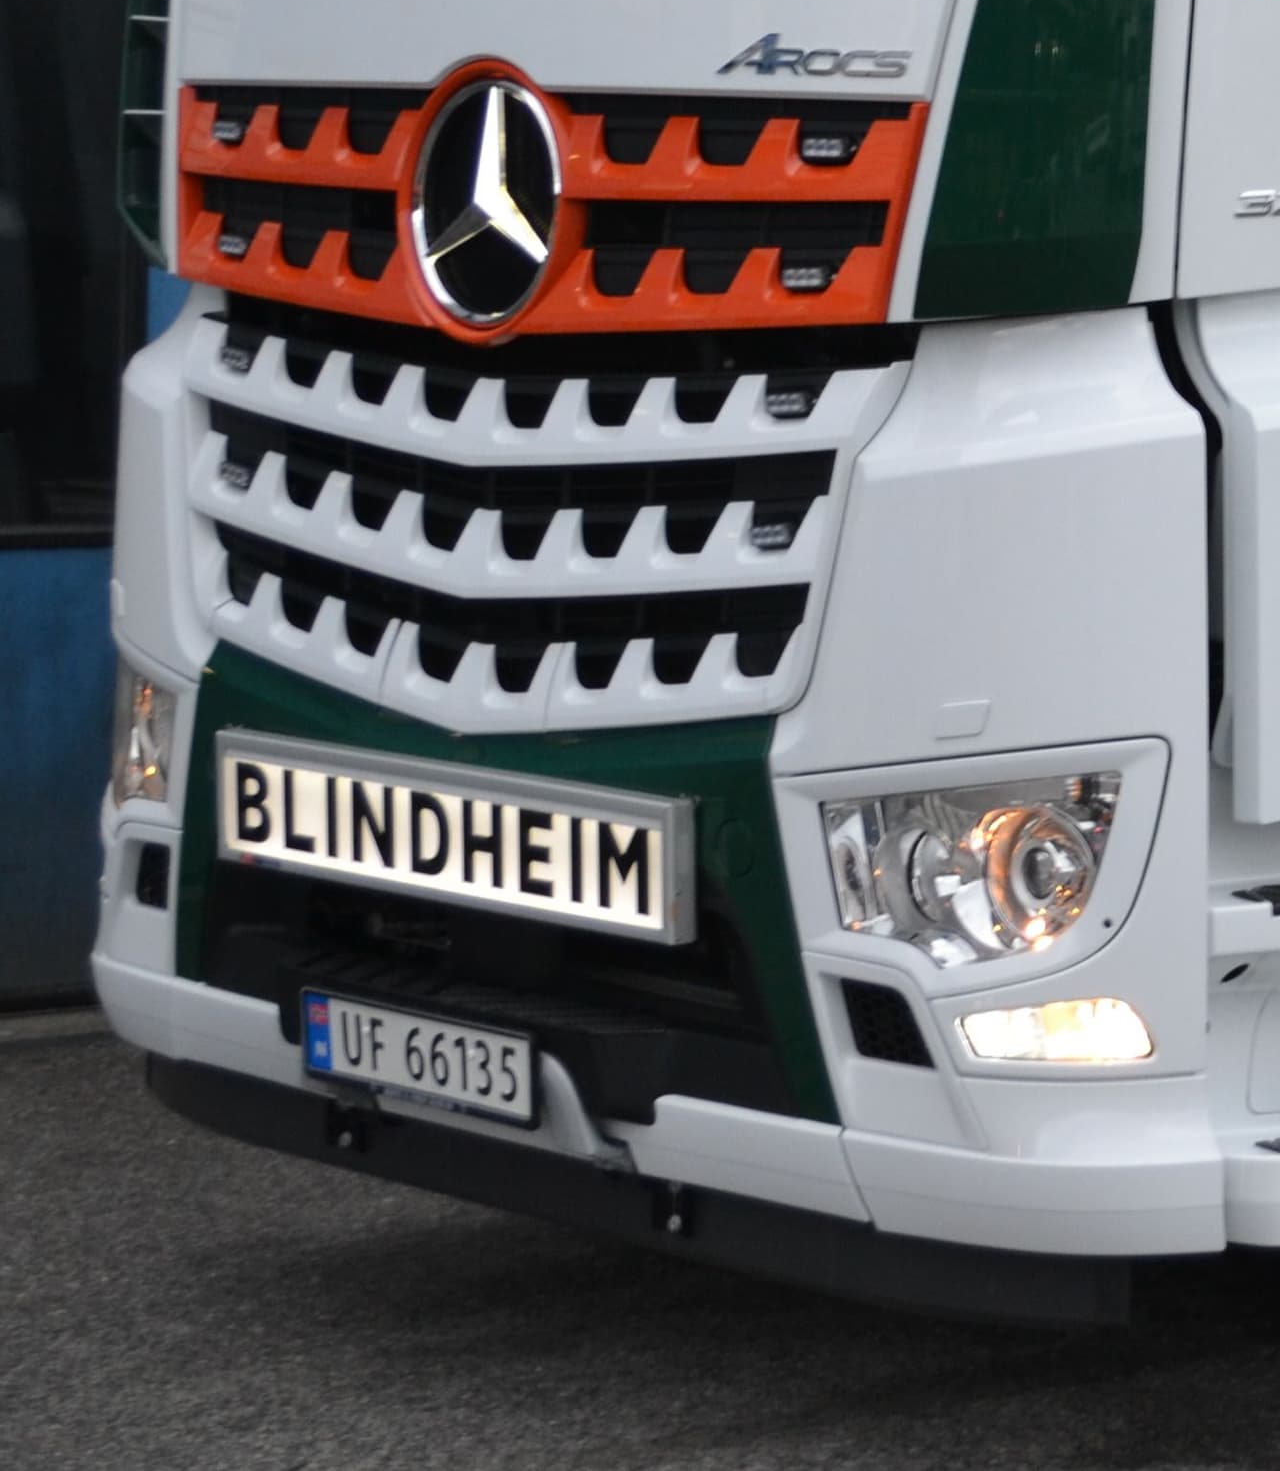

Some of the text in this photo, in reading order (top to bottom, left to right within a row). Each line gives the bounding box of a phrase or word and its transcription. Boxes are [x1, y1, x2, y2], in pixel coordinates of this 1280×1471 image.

[235, 762, 650, 916] BLINDHEIM
[341, 1011, 384, 1071] UF
[405, 1027, 518, 1102] 66135
